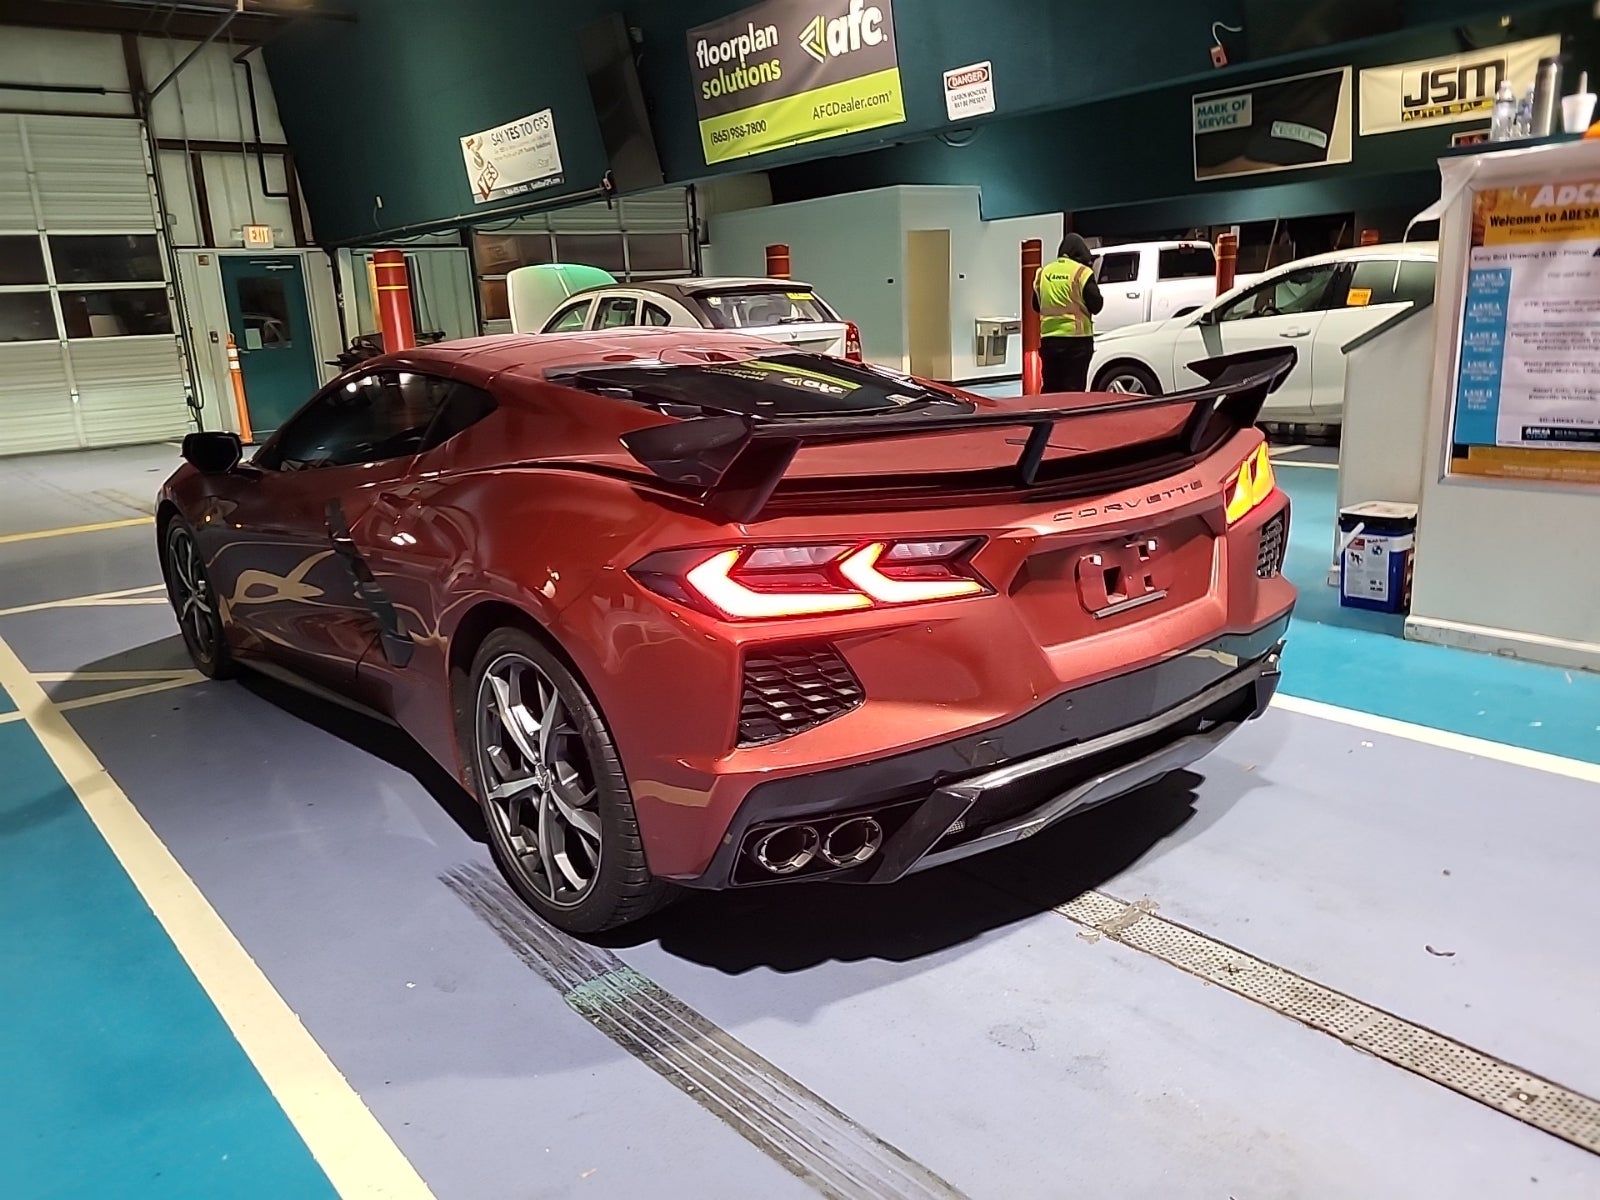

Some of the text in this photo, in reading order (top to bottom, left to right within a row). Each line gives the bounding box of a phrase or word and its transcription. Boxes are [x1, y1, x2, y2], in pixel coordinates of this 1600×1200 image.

[696, 22, 779, 69] floorplan
[702, 59, 781, 100] solutions
[951, 70, 983, 86] DANGER
[1404, 59, 1505, 108] JSM
[1197, 100, 1246, 117] MARK OF
[1198, 113, 1238, 129] SERVICE
[504, 126, 520, 141] YES
[520, 122, 533, 136] TO
[533, 115, 549, 132] GPS
[1490, 208, 1600, 227] Welcome to ADESA
[1053, 479, 1203, 522] CORVETTE
